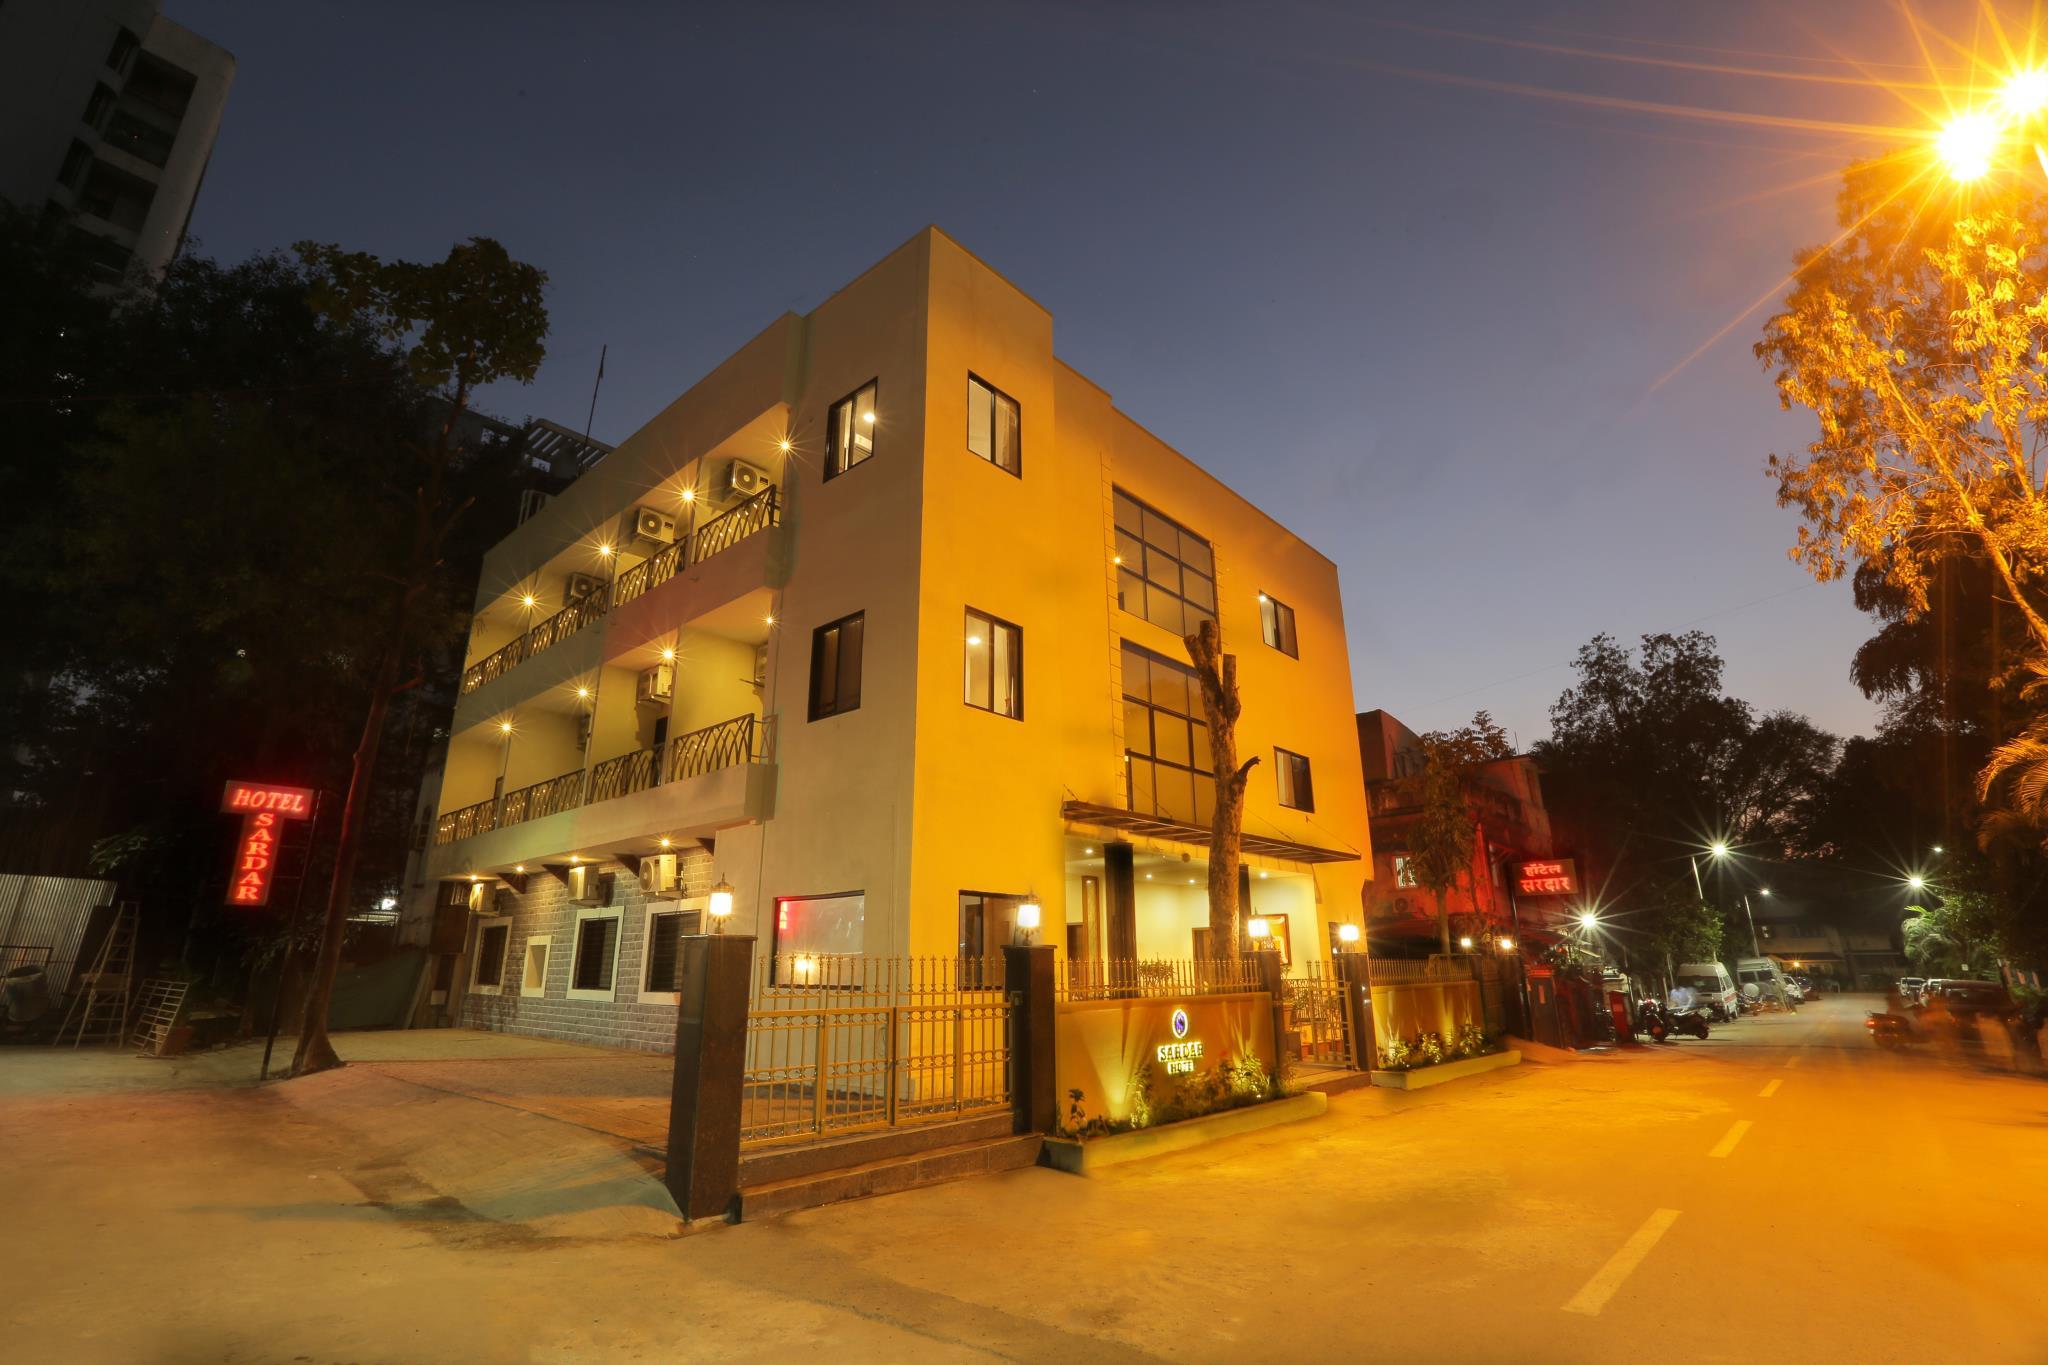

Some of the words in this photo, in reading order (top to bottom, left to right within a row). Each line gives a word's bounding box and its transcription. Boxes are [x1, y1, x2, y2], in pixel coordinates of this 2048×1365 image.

[232, 788, 304, 812] HOTEL
[236, 812, 275, 900] SARDAR
[1523, 863, 1562, 877] हॉटेल
[1520, 877, 1570, 893] सरदार
[1159, 1043, 1204, 1061] SARDAR
[1169, 1061, 1194, 1073] HOTE
